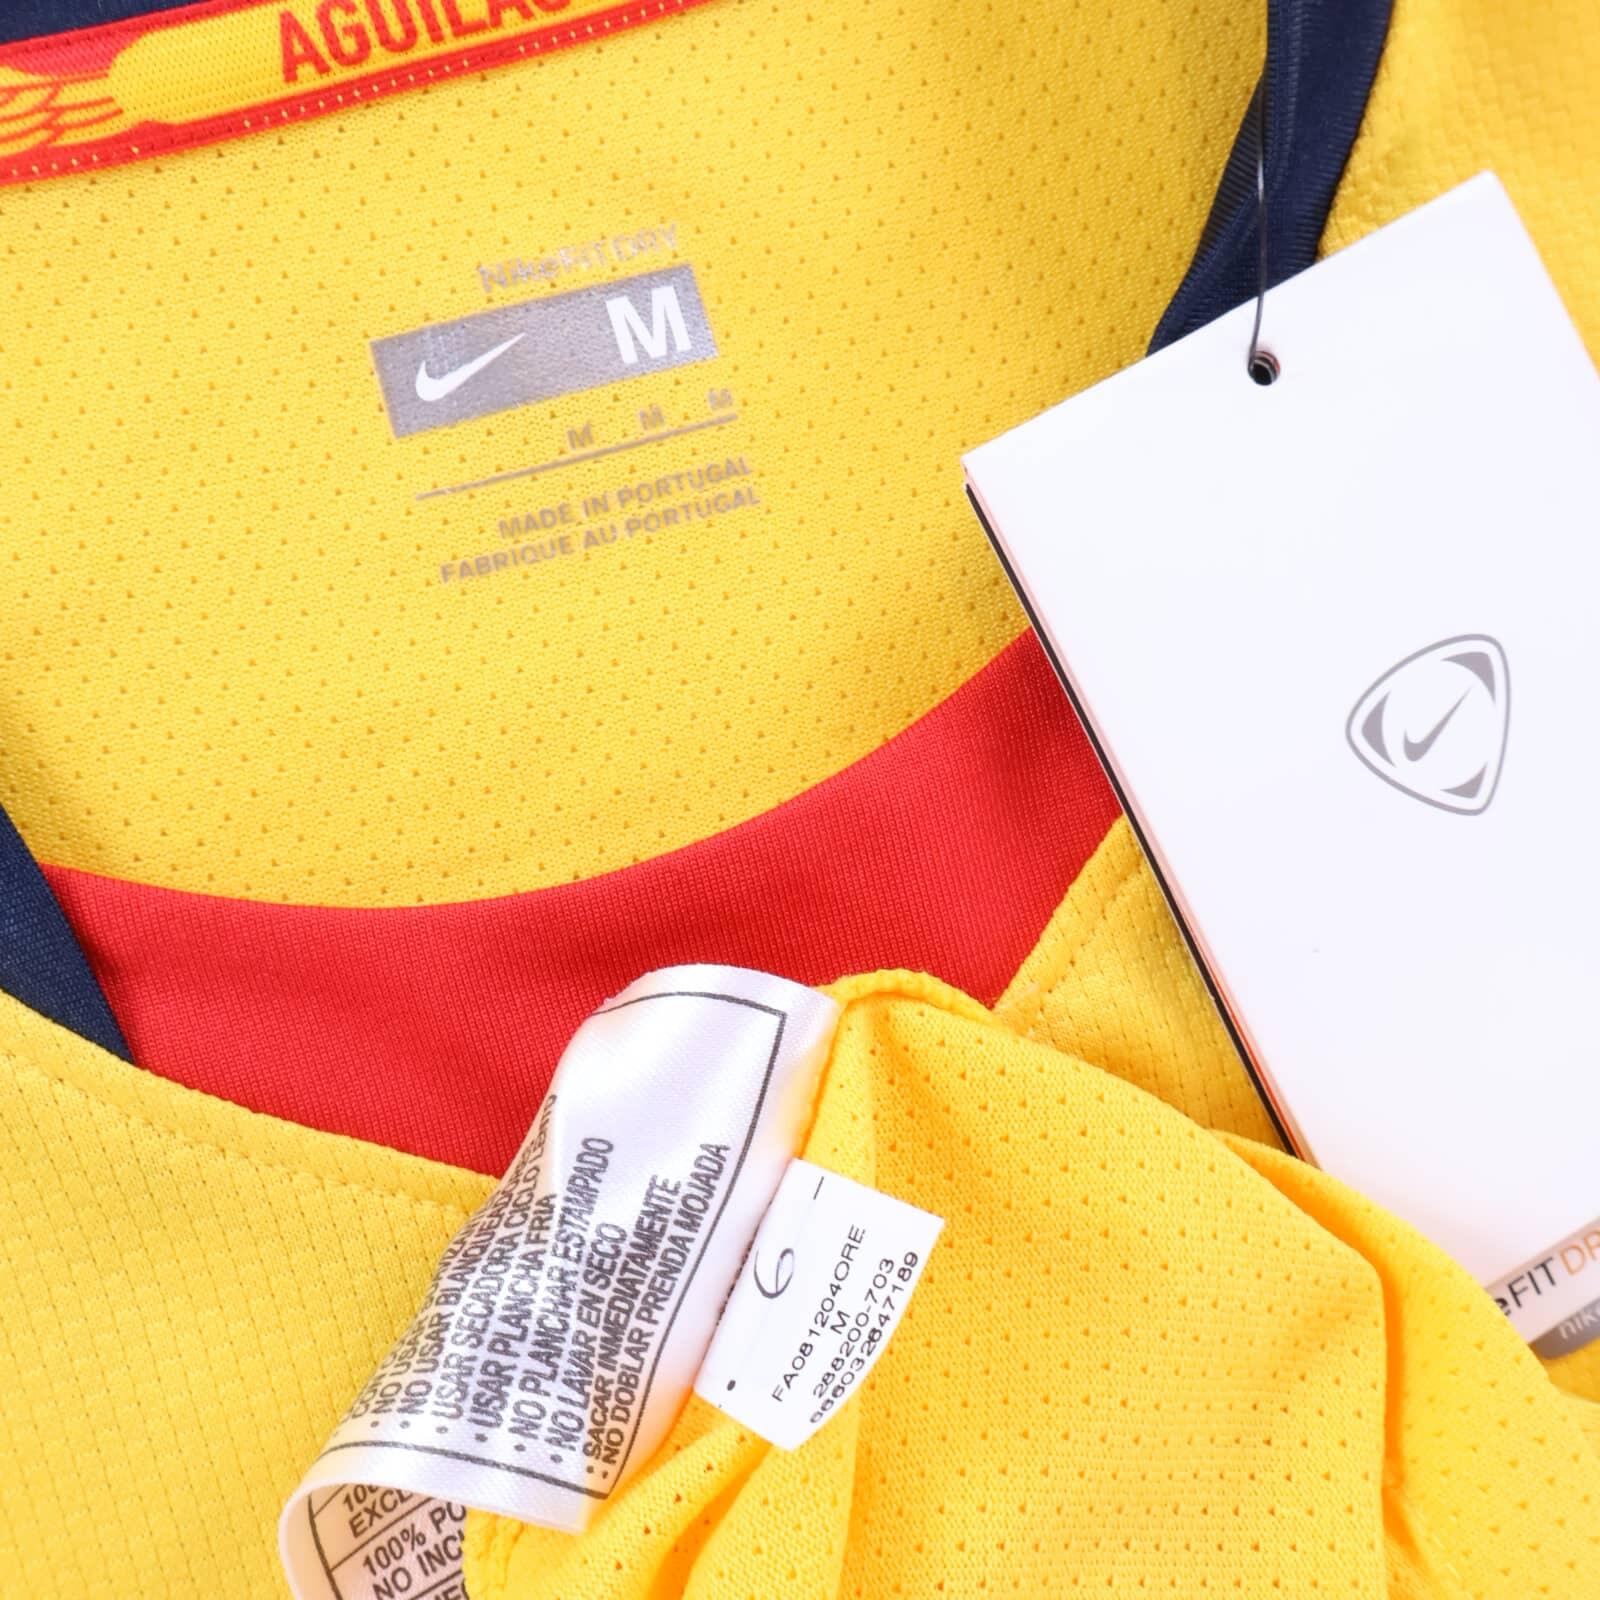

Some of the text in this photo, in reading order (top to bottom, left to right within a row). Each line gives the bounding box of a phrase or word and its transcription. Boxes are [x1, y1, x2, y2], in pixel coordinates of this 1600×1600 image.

[278, 0, 570, 83] AGUIL
[605, 285, 692, 364] M
[567, 422, 594, 450] M
[440, 486, 760, 583] FABRIQUE AU PORTUGAL
[498, 456, 753, 539] MADE IN PORTUGAL
[504, 1165, 541, 1229] CICLO
[451, 1232, 523, 1349] SECADORA
[467, 1193, 557, 1428] USAR PLANCHA FRIA
[508, 1137, 614, 1440] NO PLANCHAR ESTAMPADO
[602, 1142, 732, 1465] NO DOBLAR PRENDA MOJADA
[753, 1248, 795, 1299] 6
[413, 1312, 455, 1373] USAR
[544, 1222, 628, 1451] NO LAVAR EN SECO
[582, 1174, 682, 1460] SACAR INMEDIATAMENTE
[812, 1258, 895, 1398] 288200-703
[830, 1310, 851, 1335] M
[371, 1382, 402, 1415] NO
[397, 1380, 433, 1415] NO
[431, 1353, 478, 1419] USAR
[363, 1523, 427, 1576] 100%
[371, 1567, 412, 1600] NO
[416, 1530, 465, 1577] INC
